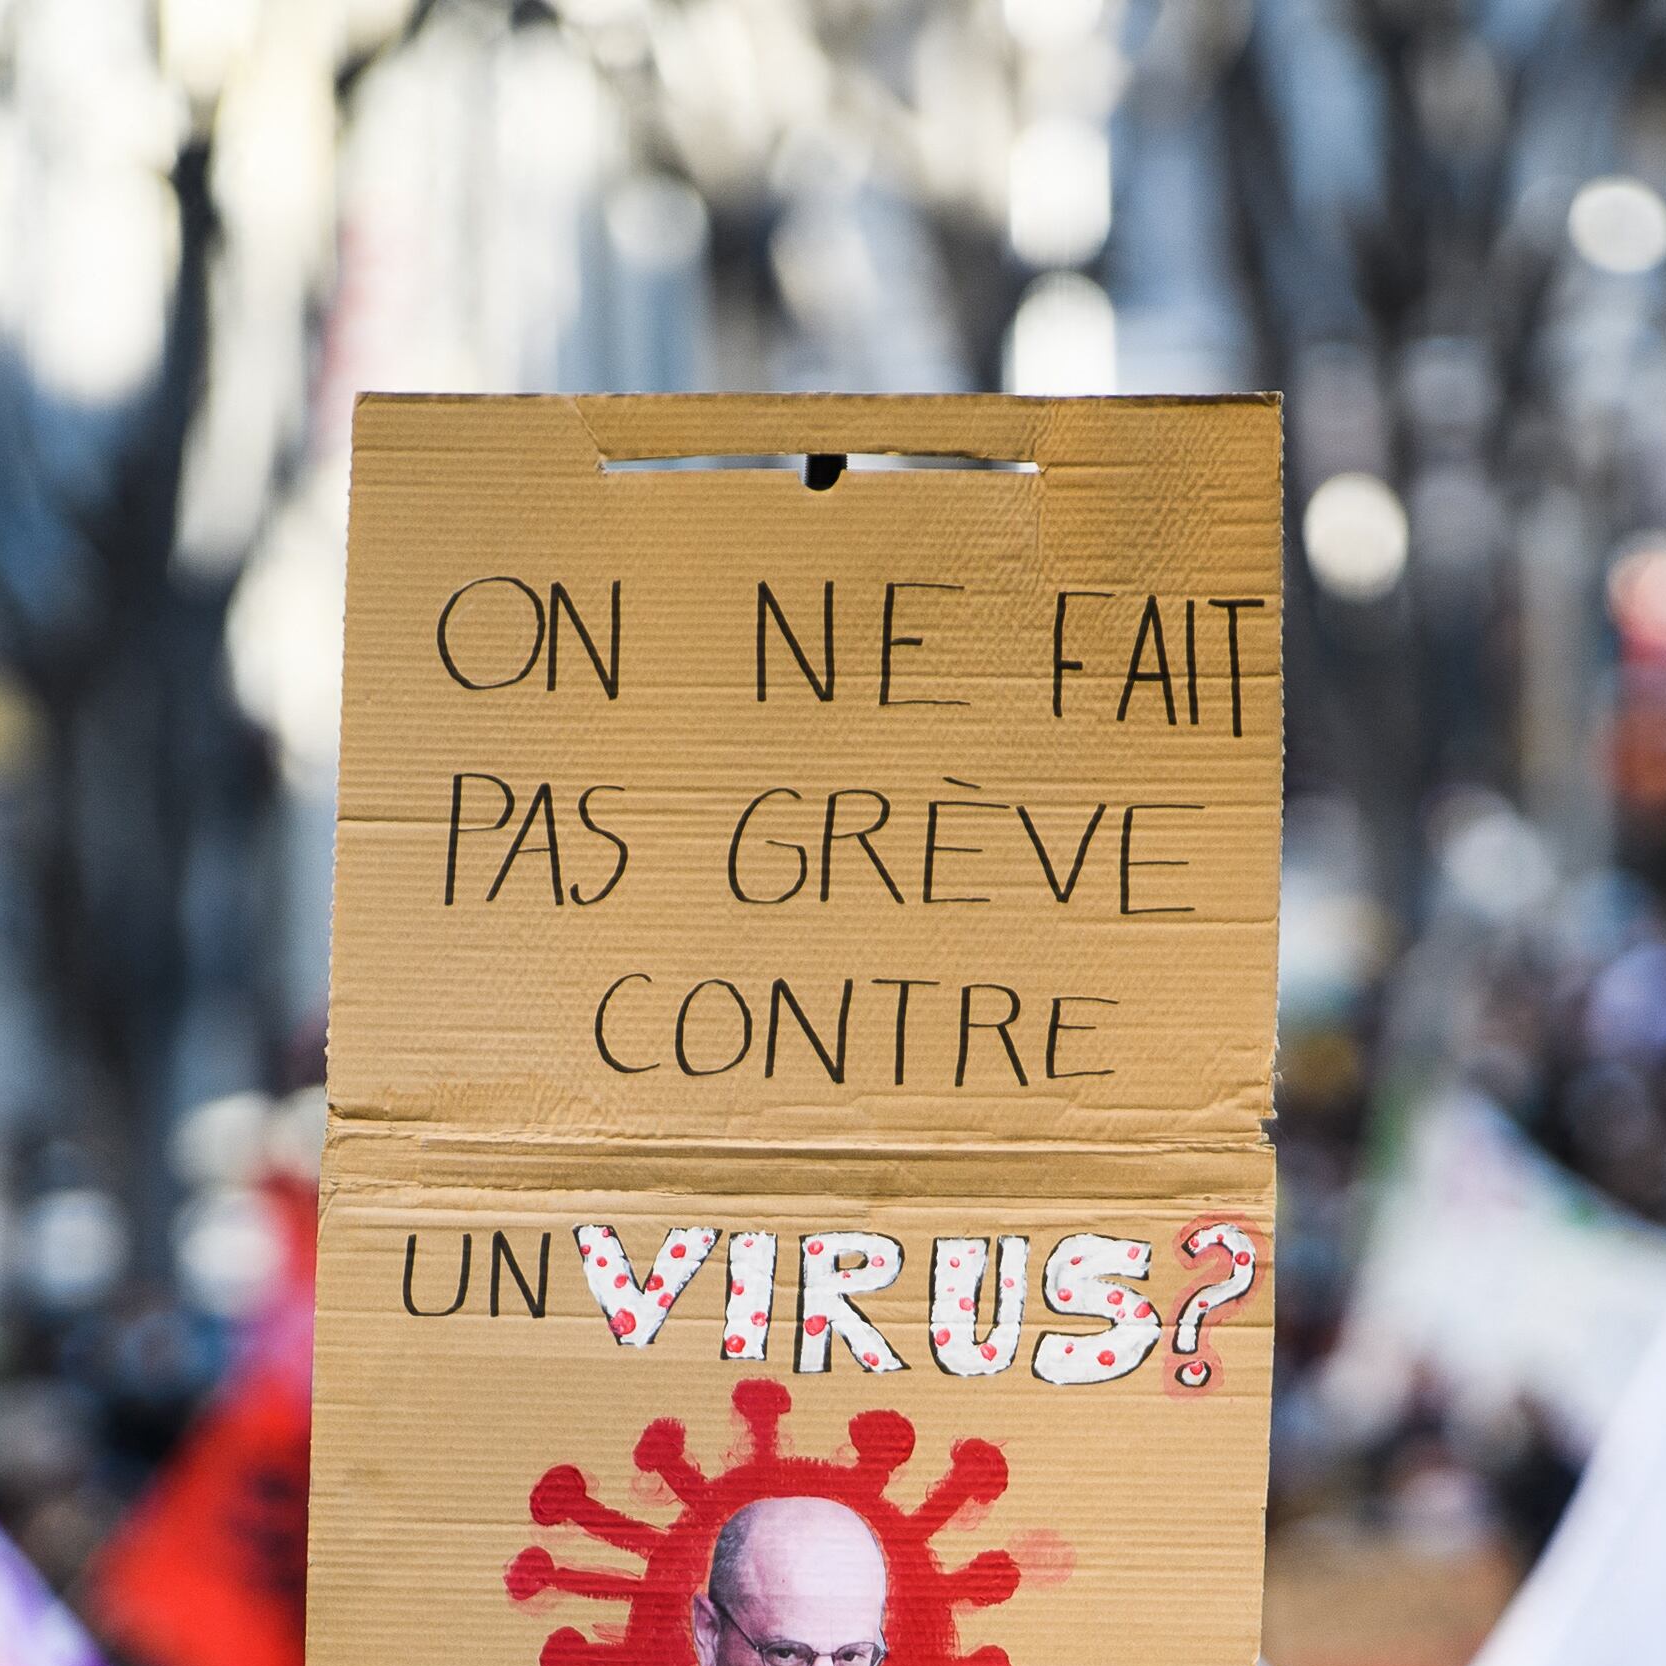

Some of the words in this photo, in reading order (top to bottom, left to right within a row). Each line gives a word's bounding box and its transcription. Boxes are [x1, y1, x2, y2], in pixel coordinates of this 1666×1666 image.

[437, 576, 621, 701] ON
[756, 580, 970, 706] NE
[1052, 591, 1265, 738] FAIT
[444, 773, 628, 906] PAS
[728, 777, 1205, 915] GRÈVE
[595, 973, 1119, 1087] CONTRE
[403, 1229, 551, 1319] UN
[572, 1220, 1259, 1388] VIRUS?
